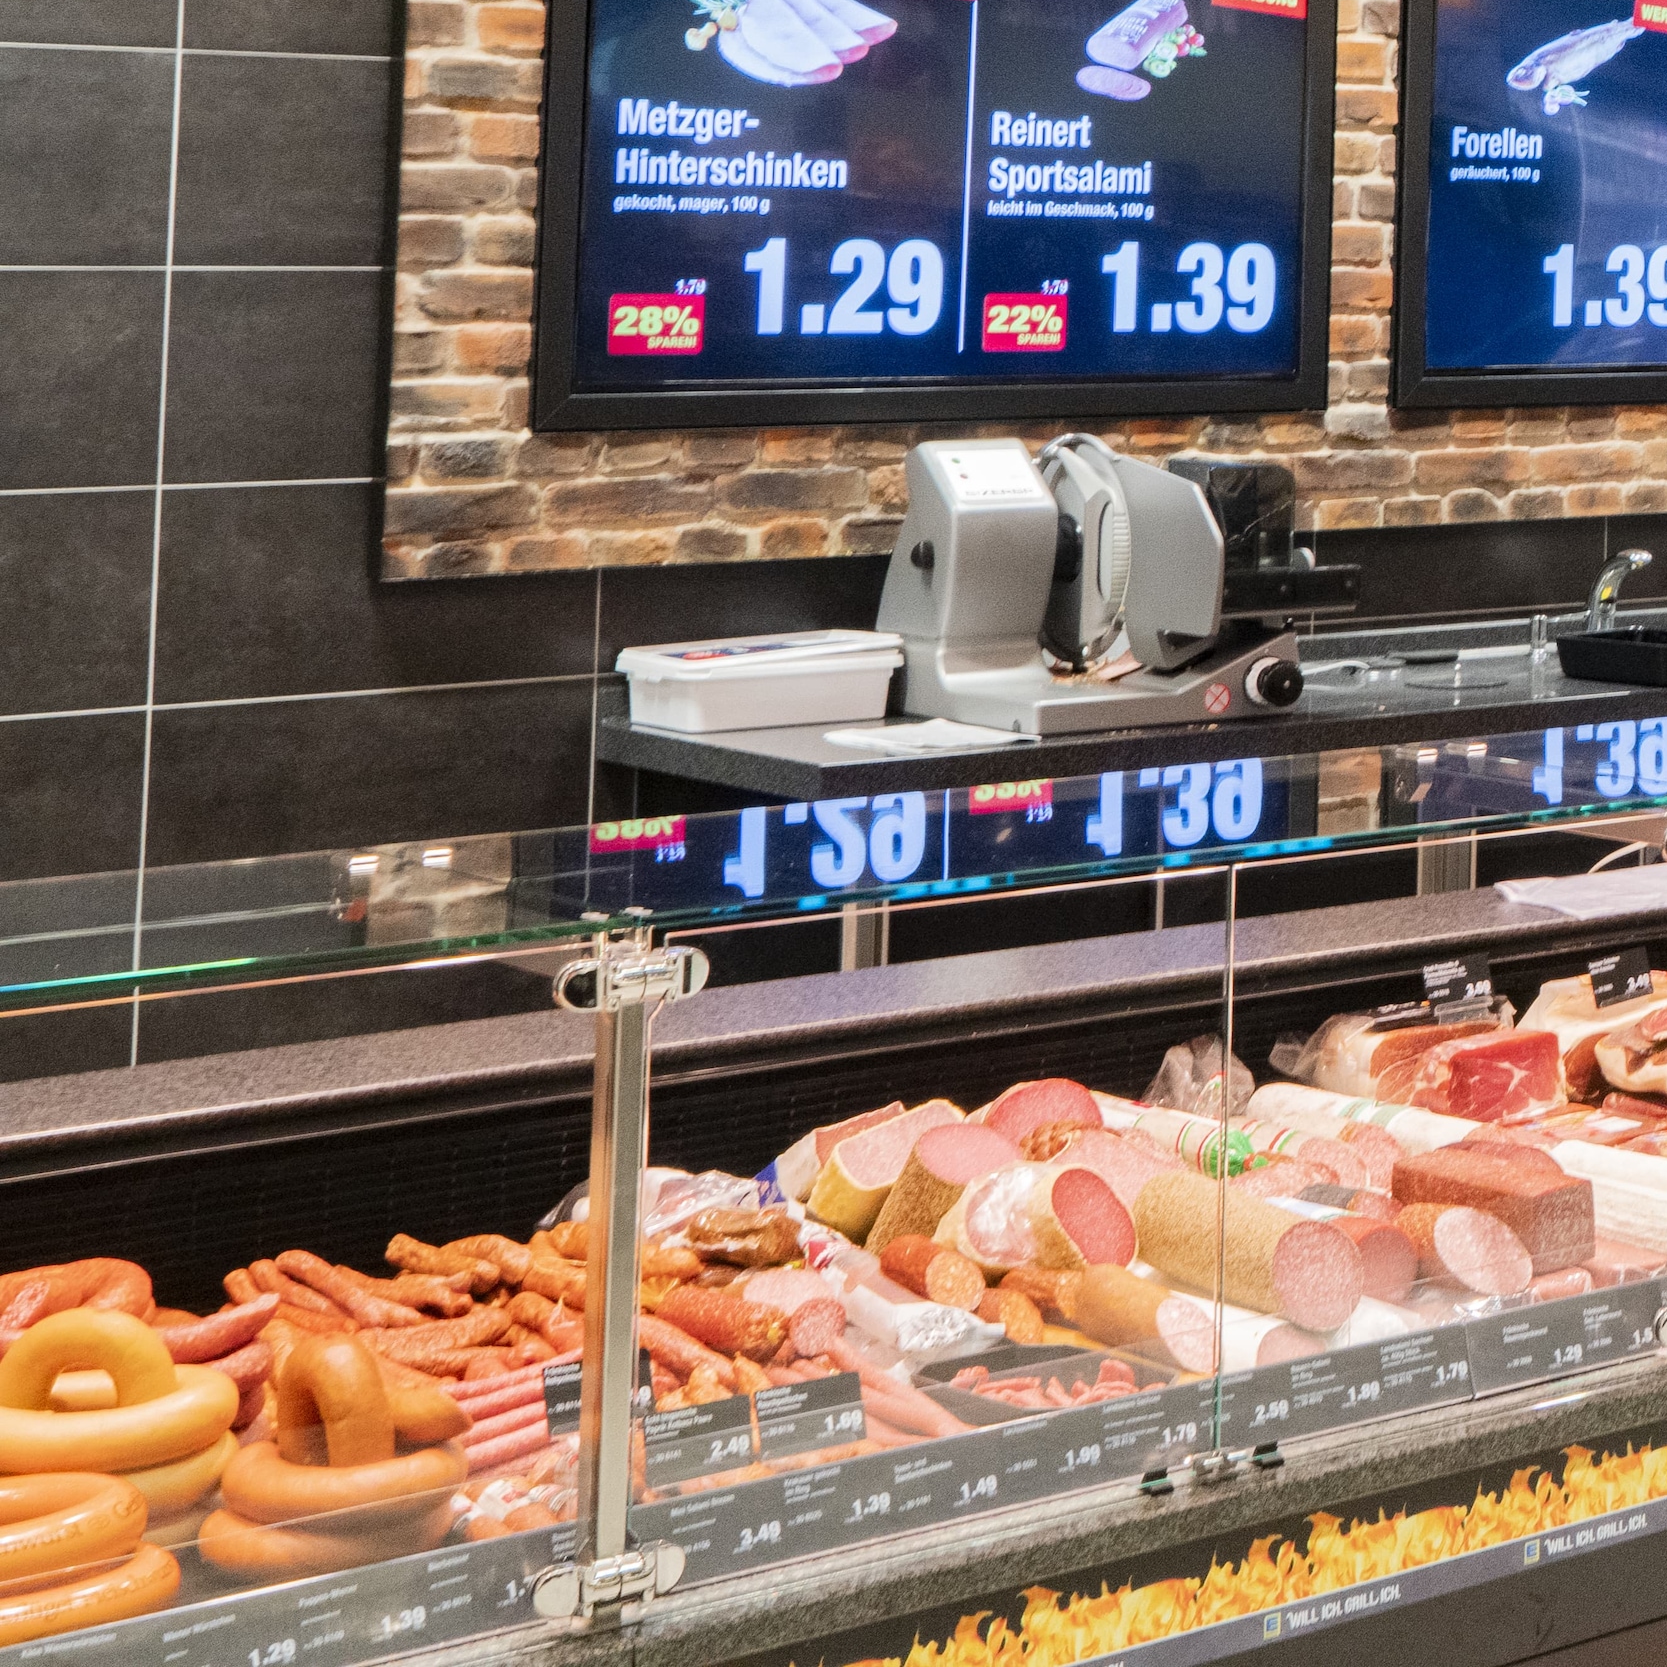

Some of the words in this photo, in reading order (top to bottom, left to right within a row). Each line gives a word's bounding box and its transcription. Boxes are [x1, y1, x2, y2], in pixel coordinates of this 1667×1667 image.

[617, 98, 759, 141] Metzger-
[991, 111, 1091, 149] Reinert
[1452, 126, 1543, 160] Forellen
[615, 149, 848, 190] Hinterschinken
[989, 157, 1151, 197] Sportsalami
[1450, 165, 1509, 182] geräuchert,
[1512, 167, 1530, 181] 100
[1533, 170, 1540, 183] g
[613, 193, 675, 214] gekocht,
[678, 196, 727, 215] mager,
[731, 195, 755, 213] 100
[760, 199, 771, 215] g
[987, 200, 1023, 217] leicht
[1044, 200, 1118, 220] Geschmack,
[1121, 202, 1141, 218] 100
[1145, 206, 1154, 220] g
[745, 237, 943, 336] 1.29
[1102, 239, 1275, 335] 1.39
[613, 305, 699, 335] 28%
[987, 305, 1063, 333] 22%
[647, 335, 697, 349] SPAREN!
[1017, 333, 1060, 345] SPAREN!
[710, 1434, 750, 1458] 2.49
[959, 1475, 997, 1500] 1.49
[851, 1492, 890, 1518] 1.39
[739, 1521, 781, 1549] 3.49
[1545, 1536, 1573, 1555] WILL
[1575, 1530, 1596, 1547] ICH.
[1597, 1520, 1628, 1544] GRILL
[1628, 1513, 1647, 1532] ICH.
[381, 1606, 426, 1634] 1.39
[1287, 1611, 1319, 1630] WILL
[1321, 1602, 1343, 1620] ICH.
[1345, 1592, 1379, 1616] GRILL
[1379, 1585, 1401, 1603] ICH.
[249, 1638, 297, 1667] 1.29
